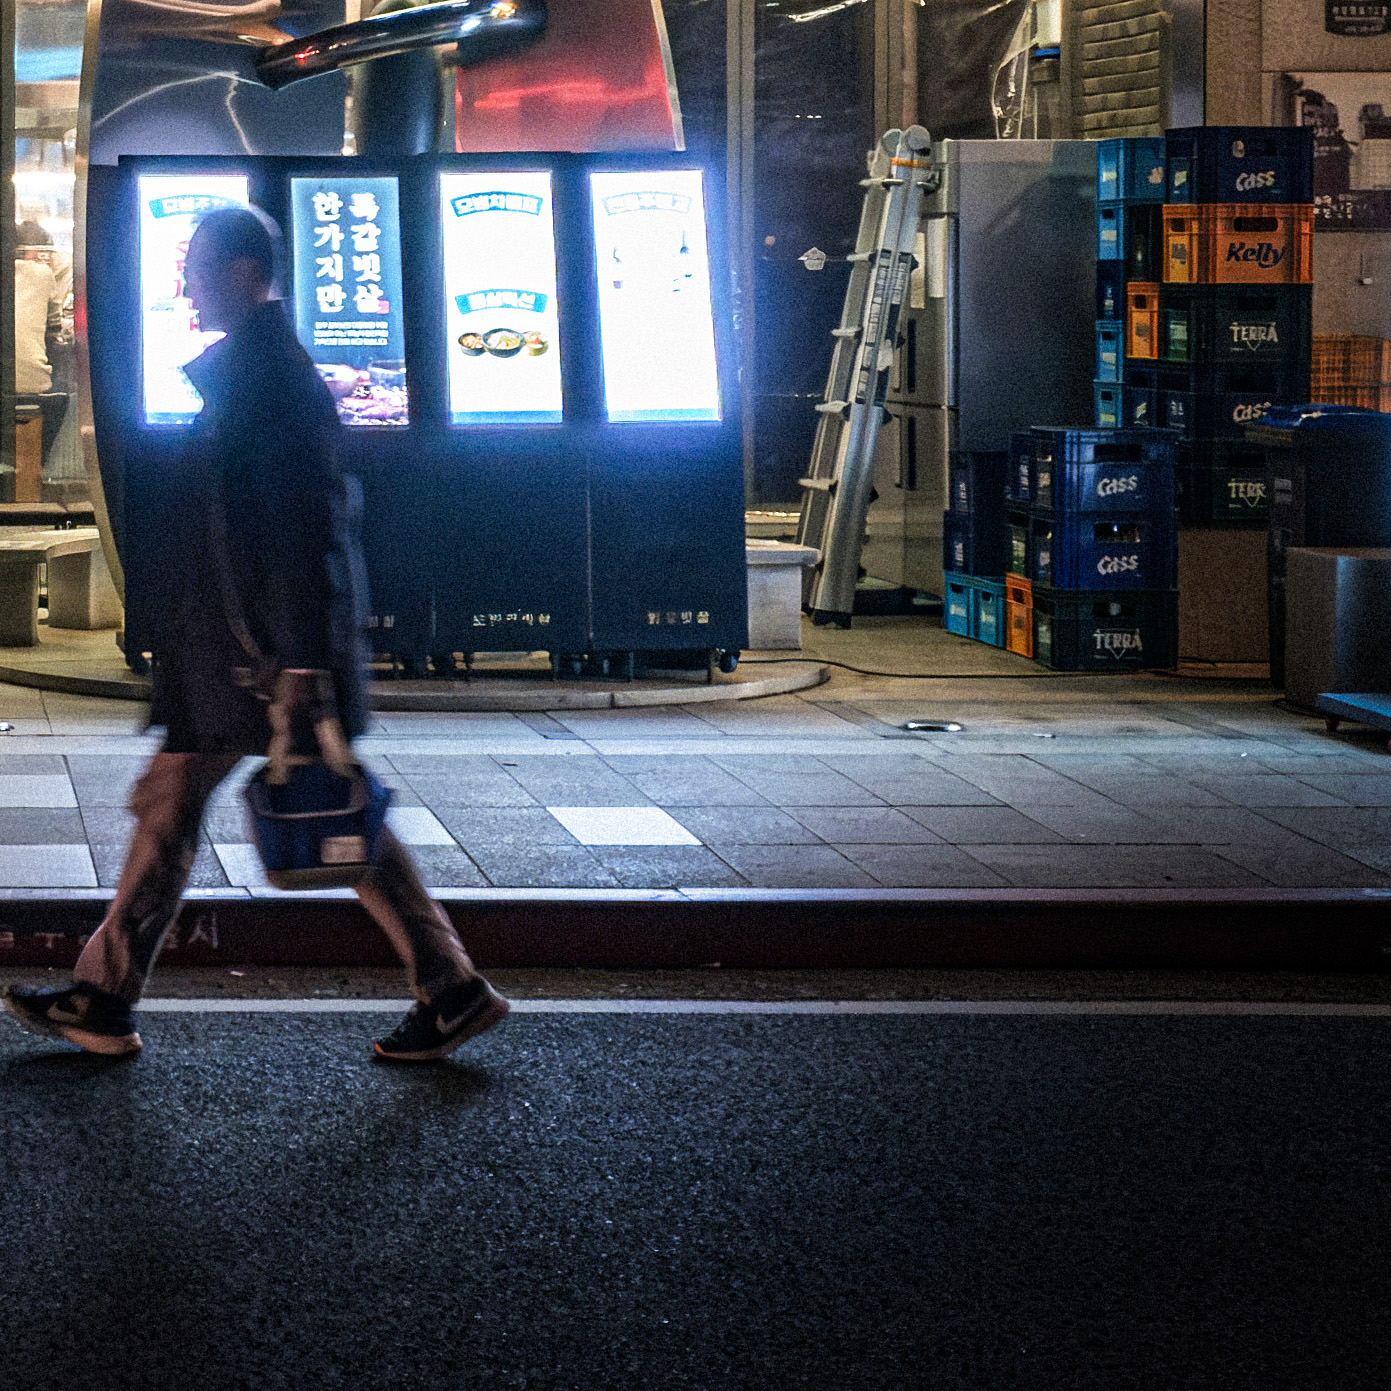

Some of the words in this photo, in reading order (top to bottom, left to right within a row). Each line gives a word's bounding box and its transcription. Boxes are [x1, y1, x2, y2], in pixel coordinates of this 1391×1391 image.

[1236, 171, 1275, 191] Cass
[312, 192, 347, 313] 한가지만
[1226, 242, 1287, 268] Kelly
[1229, 321, 1279, 343] TERRA
[1097, 475, 1138, 497] Cass
[1097, 555, 1139, 575] Cass
[1093, 629, 1143, 651] TERRA
